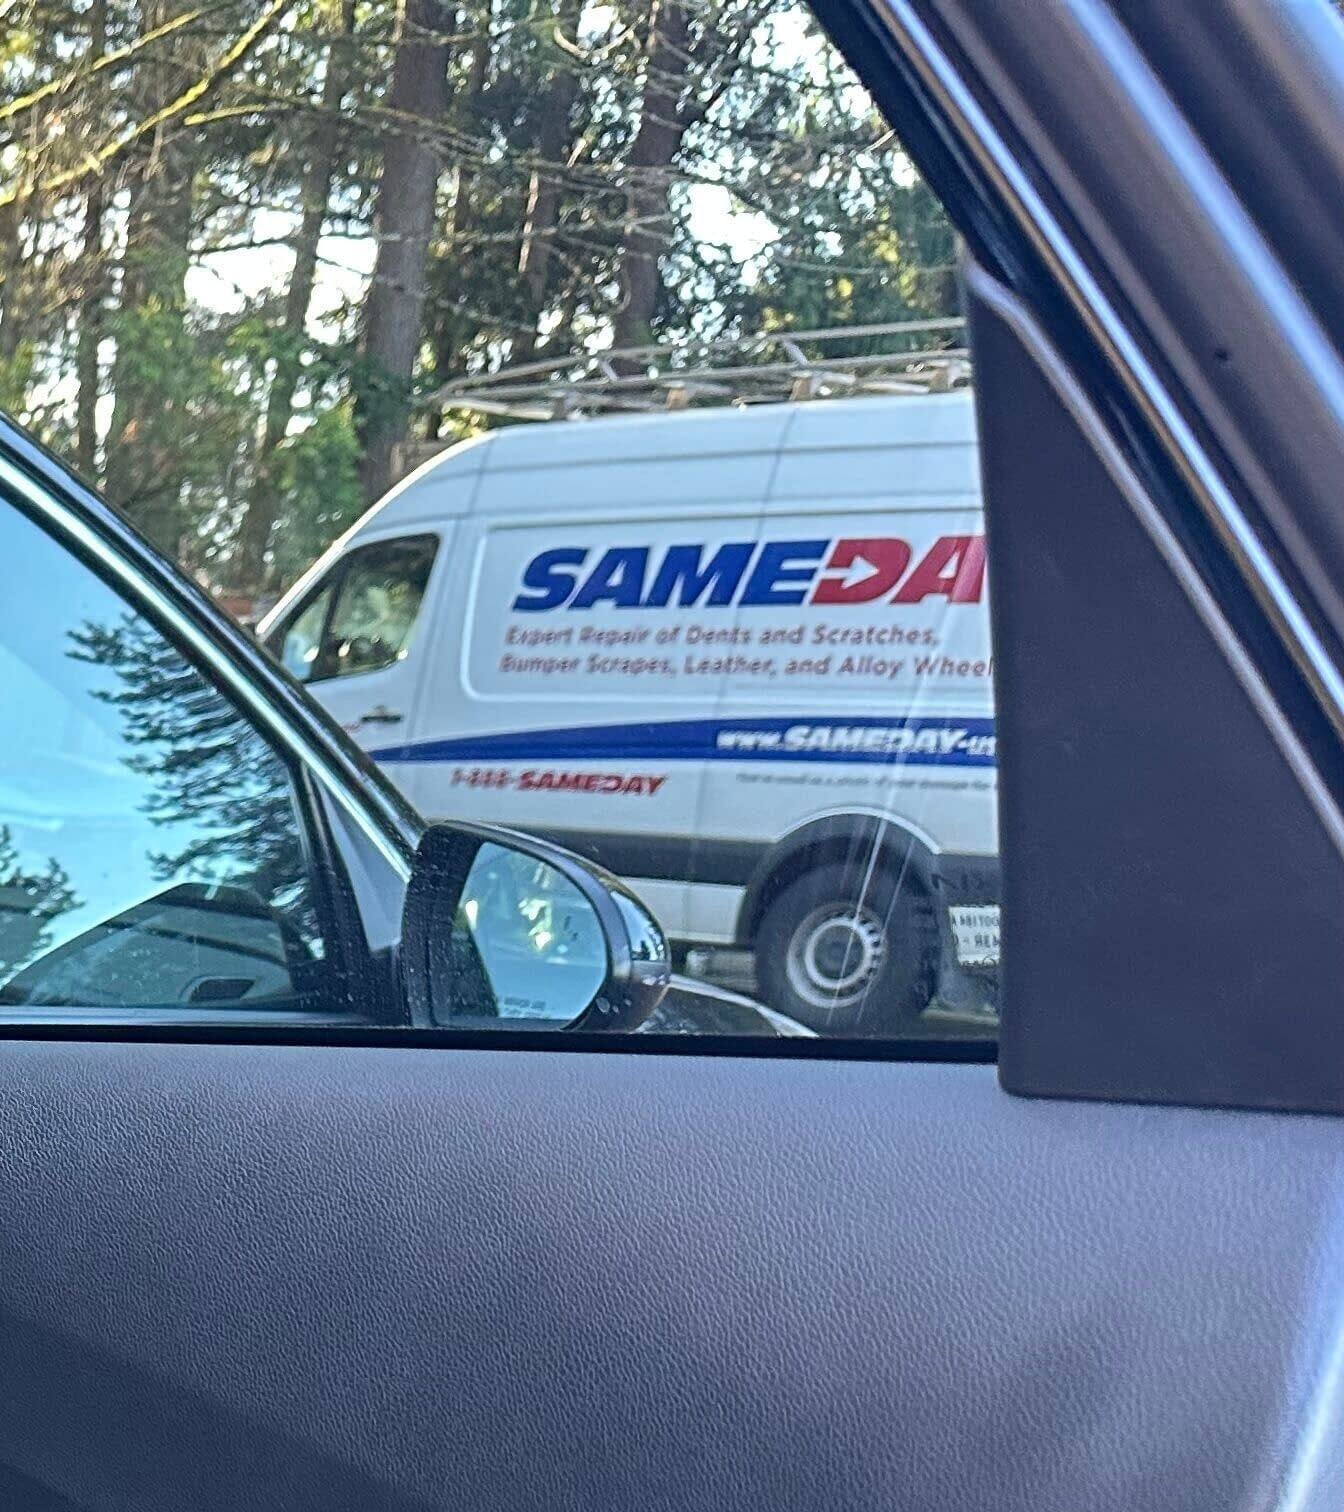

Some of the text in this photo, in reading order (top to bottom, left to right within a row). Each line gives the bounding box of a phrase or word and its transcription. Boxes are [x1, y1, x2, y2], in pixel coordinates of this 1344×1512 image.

[505, 624, 940, 647] Expert Repair of Dents and Scratches,
[499, 653, 580, 675] Bumper
[585, 653, 678, 677] Scrapes,
[684, 654, 777, 678] Leather,
[784, 655, 832, 676] and
[838, 656, 905, 680] Alloy
